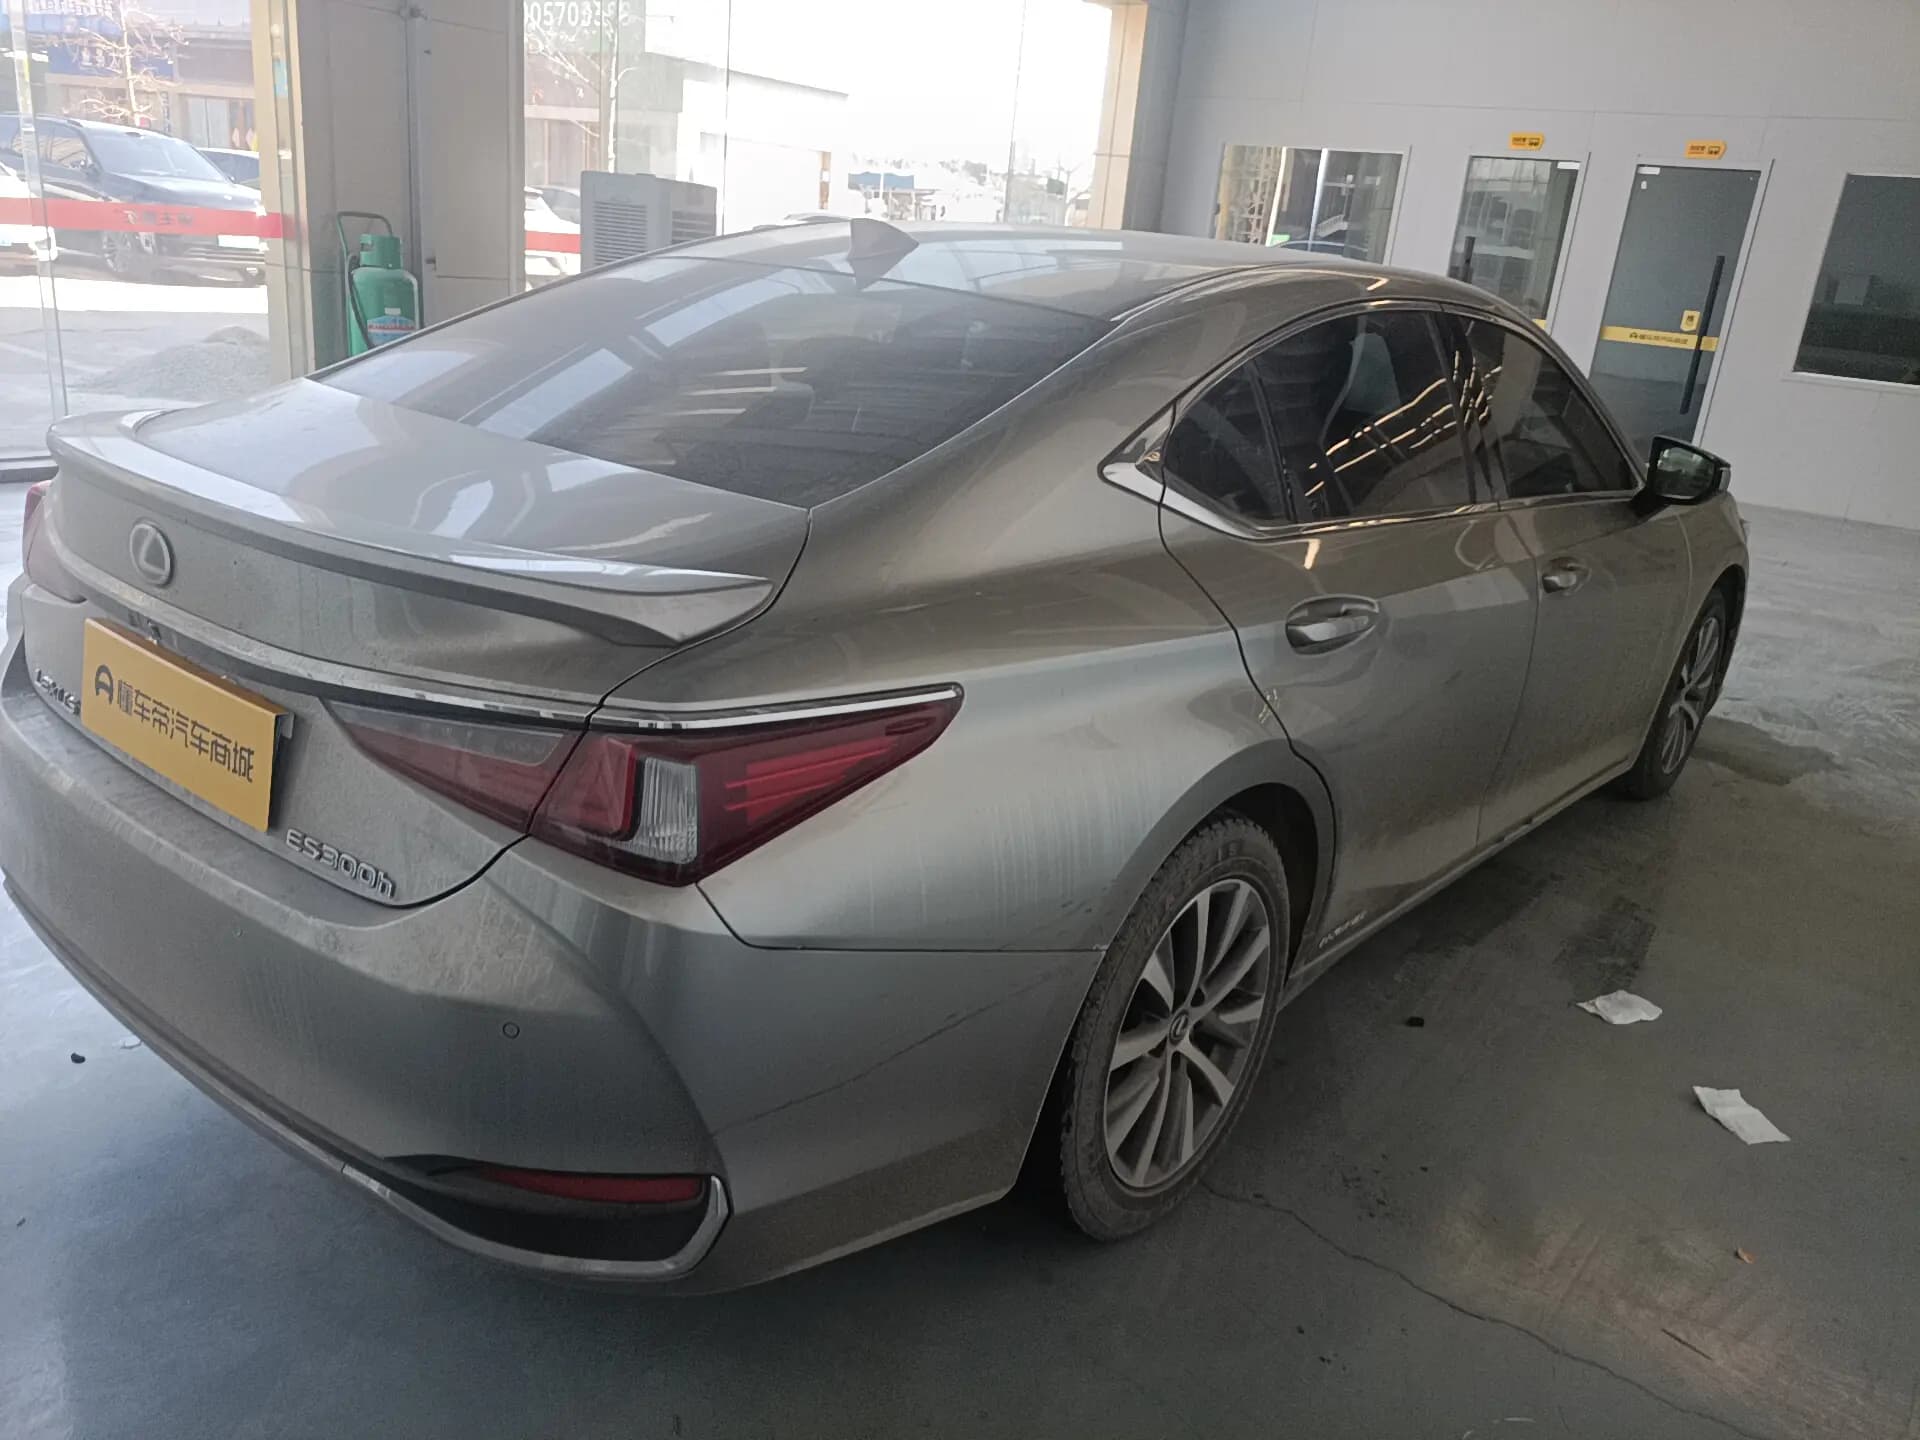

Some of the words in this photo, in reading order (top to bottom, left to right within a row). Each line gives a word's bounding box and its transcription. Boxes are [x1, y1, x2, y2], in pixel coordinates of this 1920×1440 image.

[117, 679, 255, 783] 懂车帝汽车商城
[285, 828, 395, 898] ES300h
